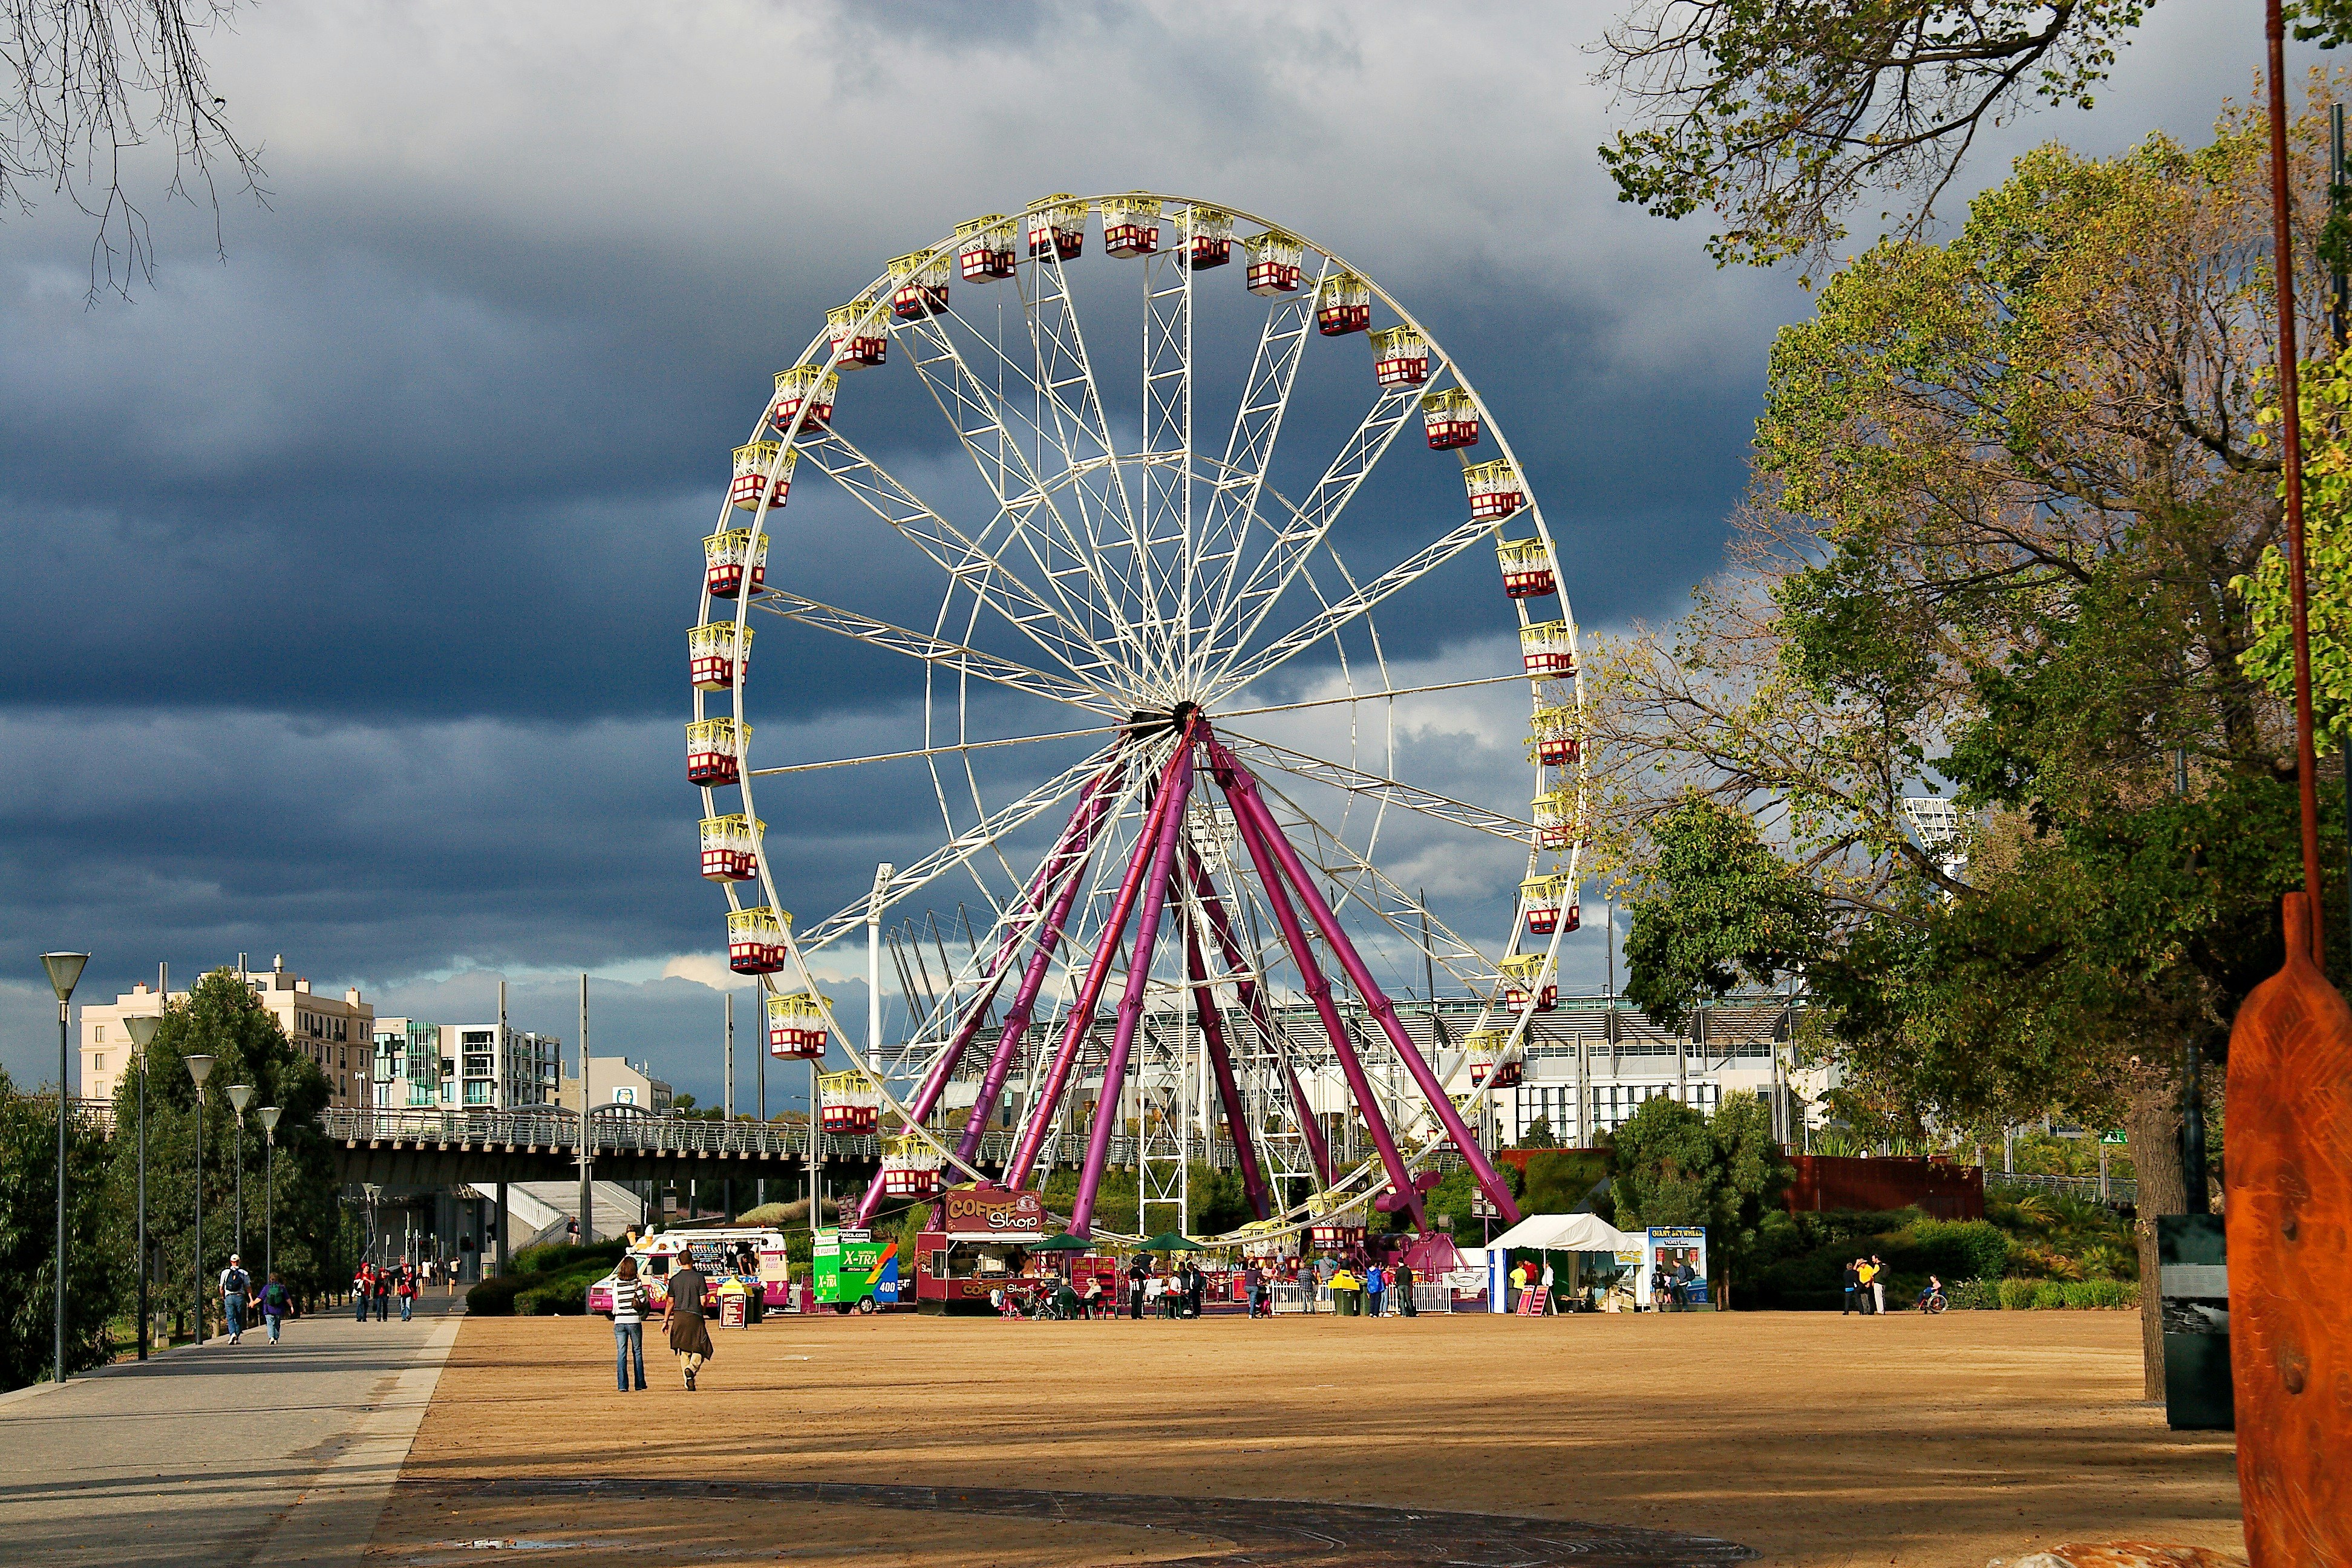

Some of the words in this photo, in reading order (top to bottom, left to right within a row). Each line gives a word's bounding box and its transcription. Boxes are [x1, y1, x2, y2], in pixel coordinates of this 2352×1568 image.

[949, 1198, 1017, 1220] COFFEE
[988, 1212, 1037, 1231] Shop
[843, 1250, 878, 1265] X-TRA
[817, 1275, 837, 1288] X-TRA
[880, 1282, 896, 1293] 400
[962, 1281, 1006, 1295] COFFEE
[1007, 1284, 1028, 1295] Shop
